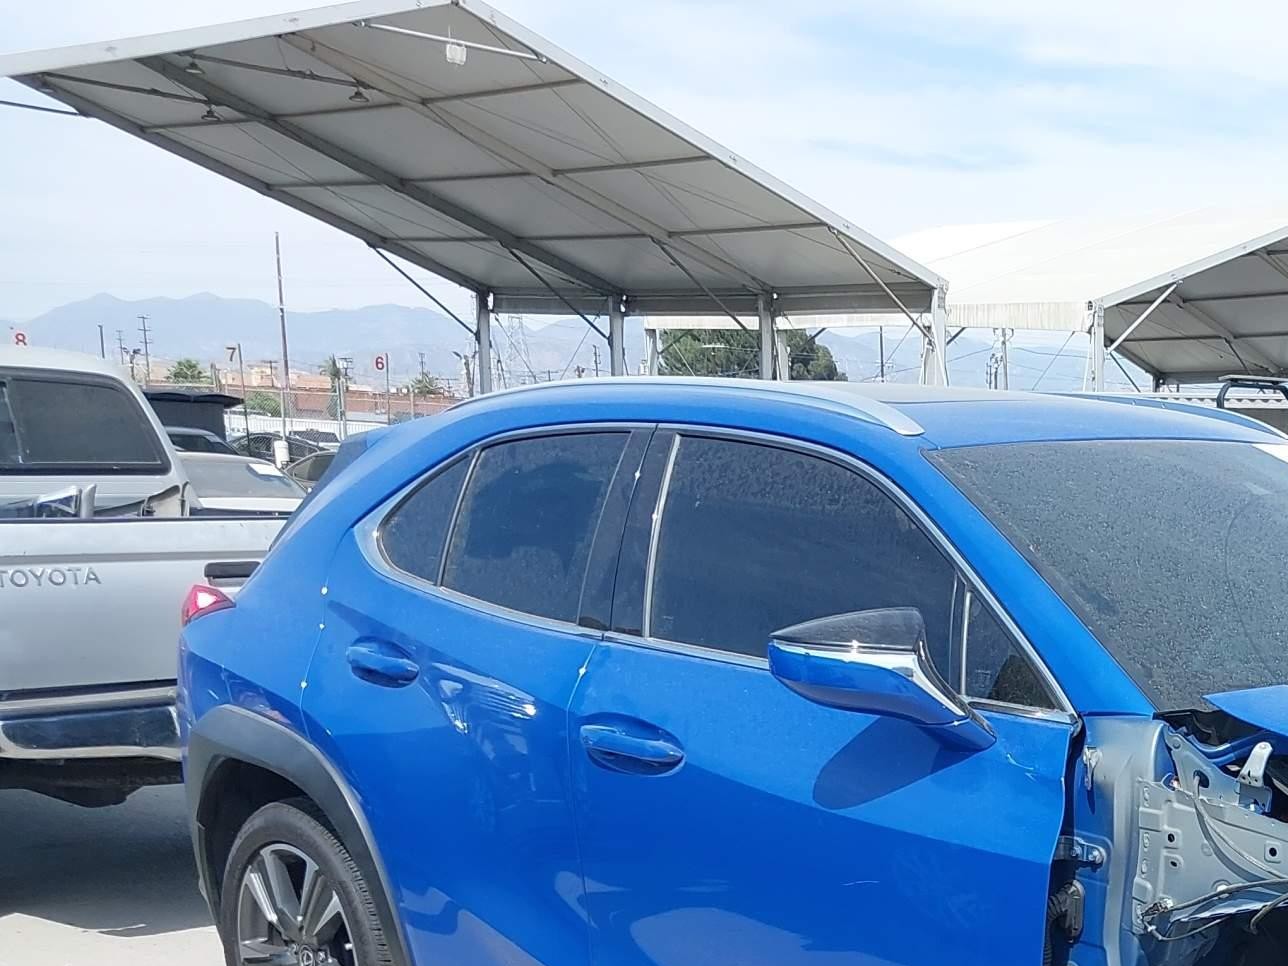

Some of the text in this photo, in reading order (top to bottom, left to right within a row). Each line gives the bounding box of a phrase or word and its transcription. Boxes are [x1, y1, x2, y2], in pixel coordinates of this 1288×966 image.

[226, 347, 236, 361] 7
[375, 356, 385, 370] 6
[0, 567, 102, 588] TOYOTA
